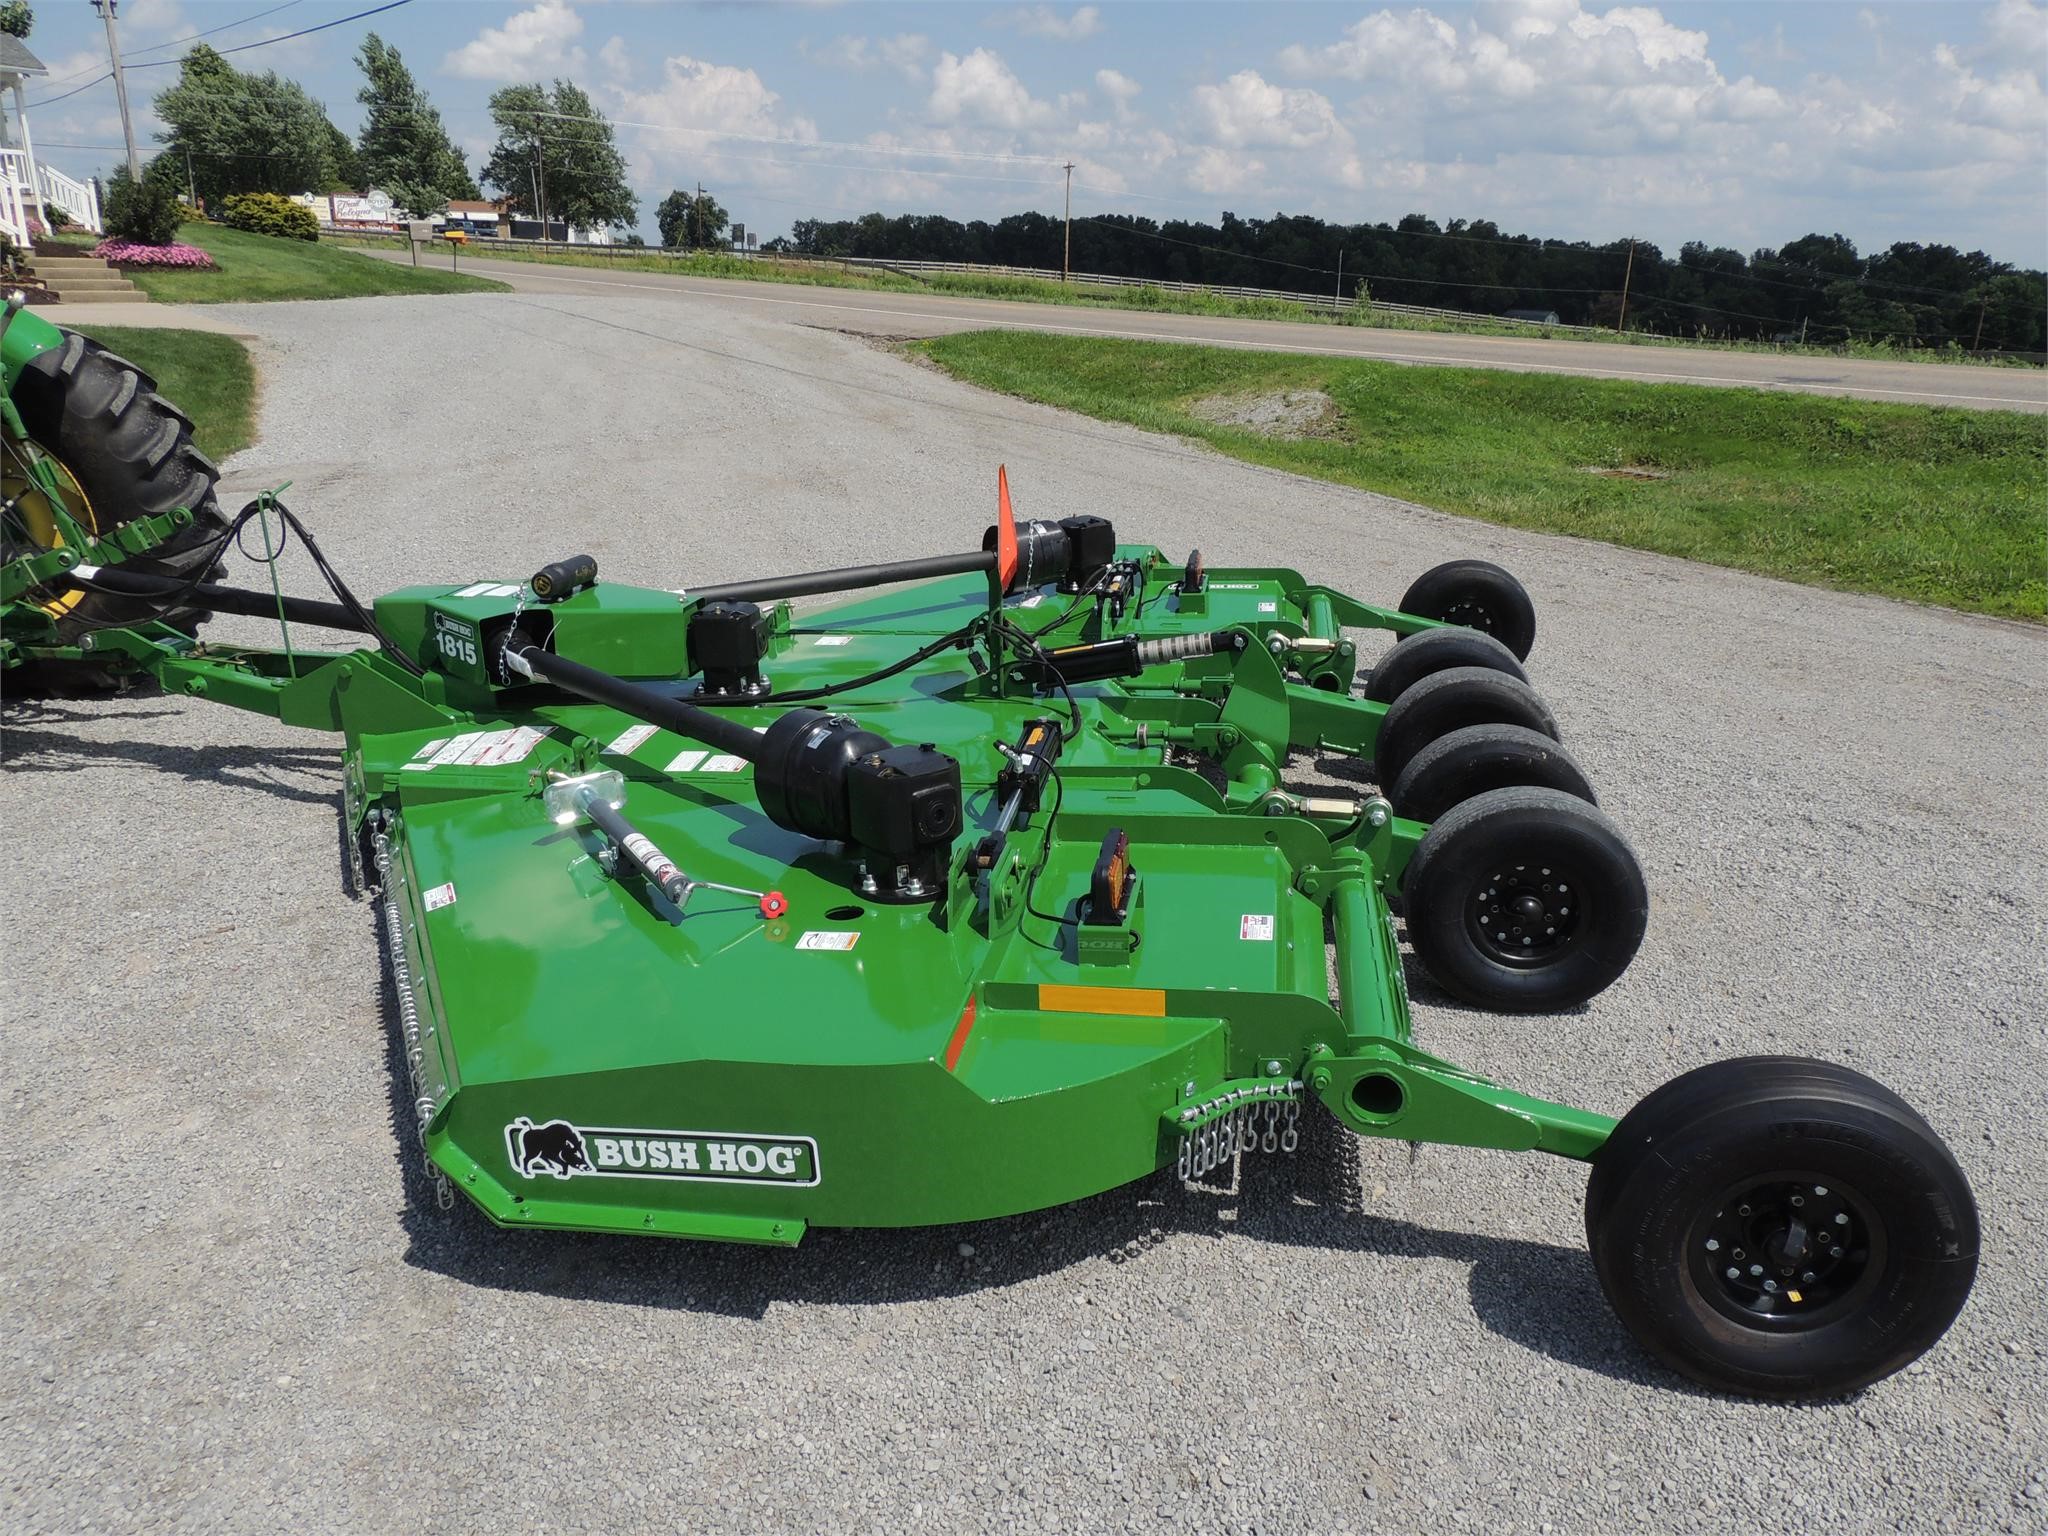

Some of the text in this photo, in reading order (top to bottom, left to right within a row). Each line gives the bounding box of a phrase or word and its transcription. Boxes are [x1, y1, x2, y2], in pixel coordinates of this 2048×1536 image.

[436, 632, 477, 665] 1815
[594, 1138, 796, 1175] BUSH HOG
